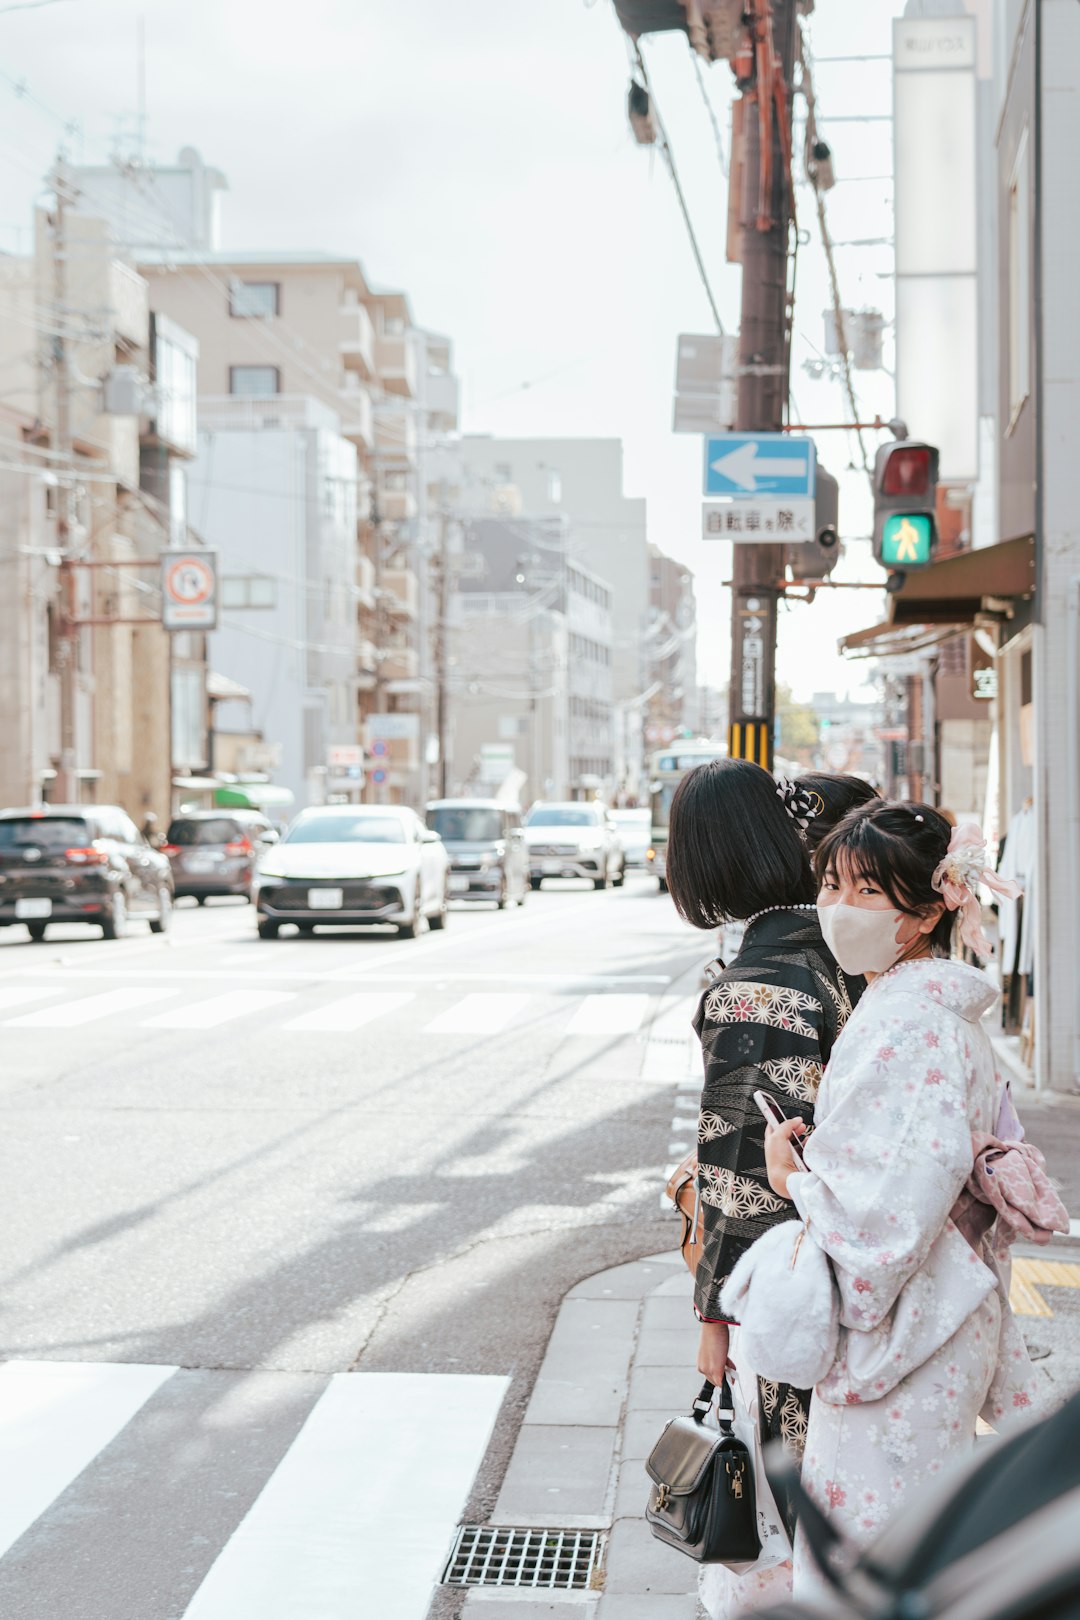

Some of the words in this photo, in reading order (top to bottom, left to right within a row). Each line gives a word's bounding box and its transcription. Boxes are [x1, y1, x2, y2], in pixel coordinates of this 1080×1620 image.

[708, 510, 807, 532] 自転車を除く
